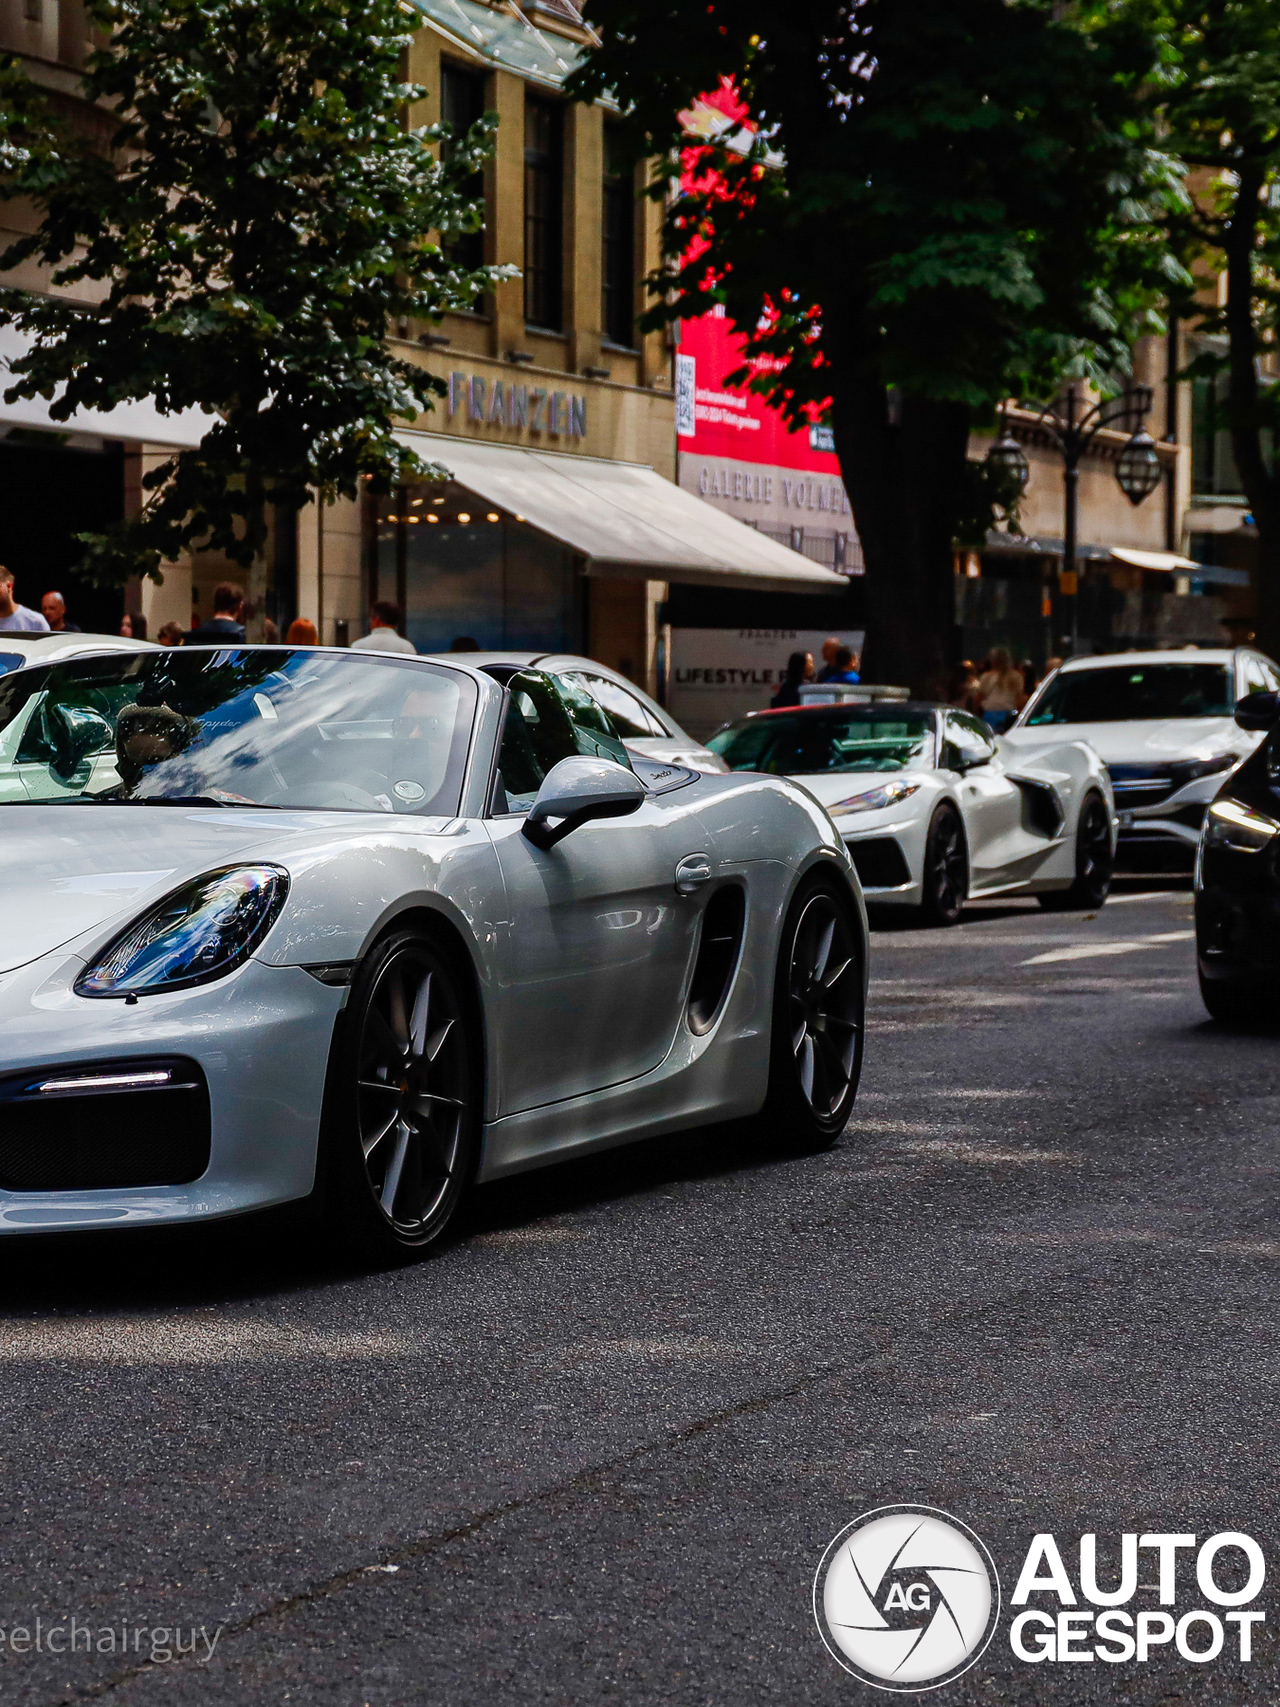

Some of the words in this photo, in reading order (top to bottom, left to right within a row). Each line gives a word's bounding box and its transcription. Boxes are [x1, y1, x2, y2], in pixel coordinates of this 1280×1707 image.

[449, 371, 587, 437] FRANZEN
[699, 466, 772, 504] GALERIE
[675, 668, 773, 684] LIFESTYLE
